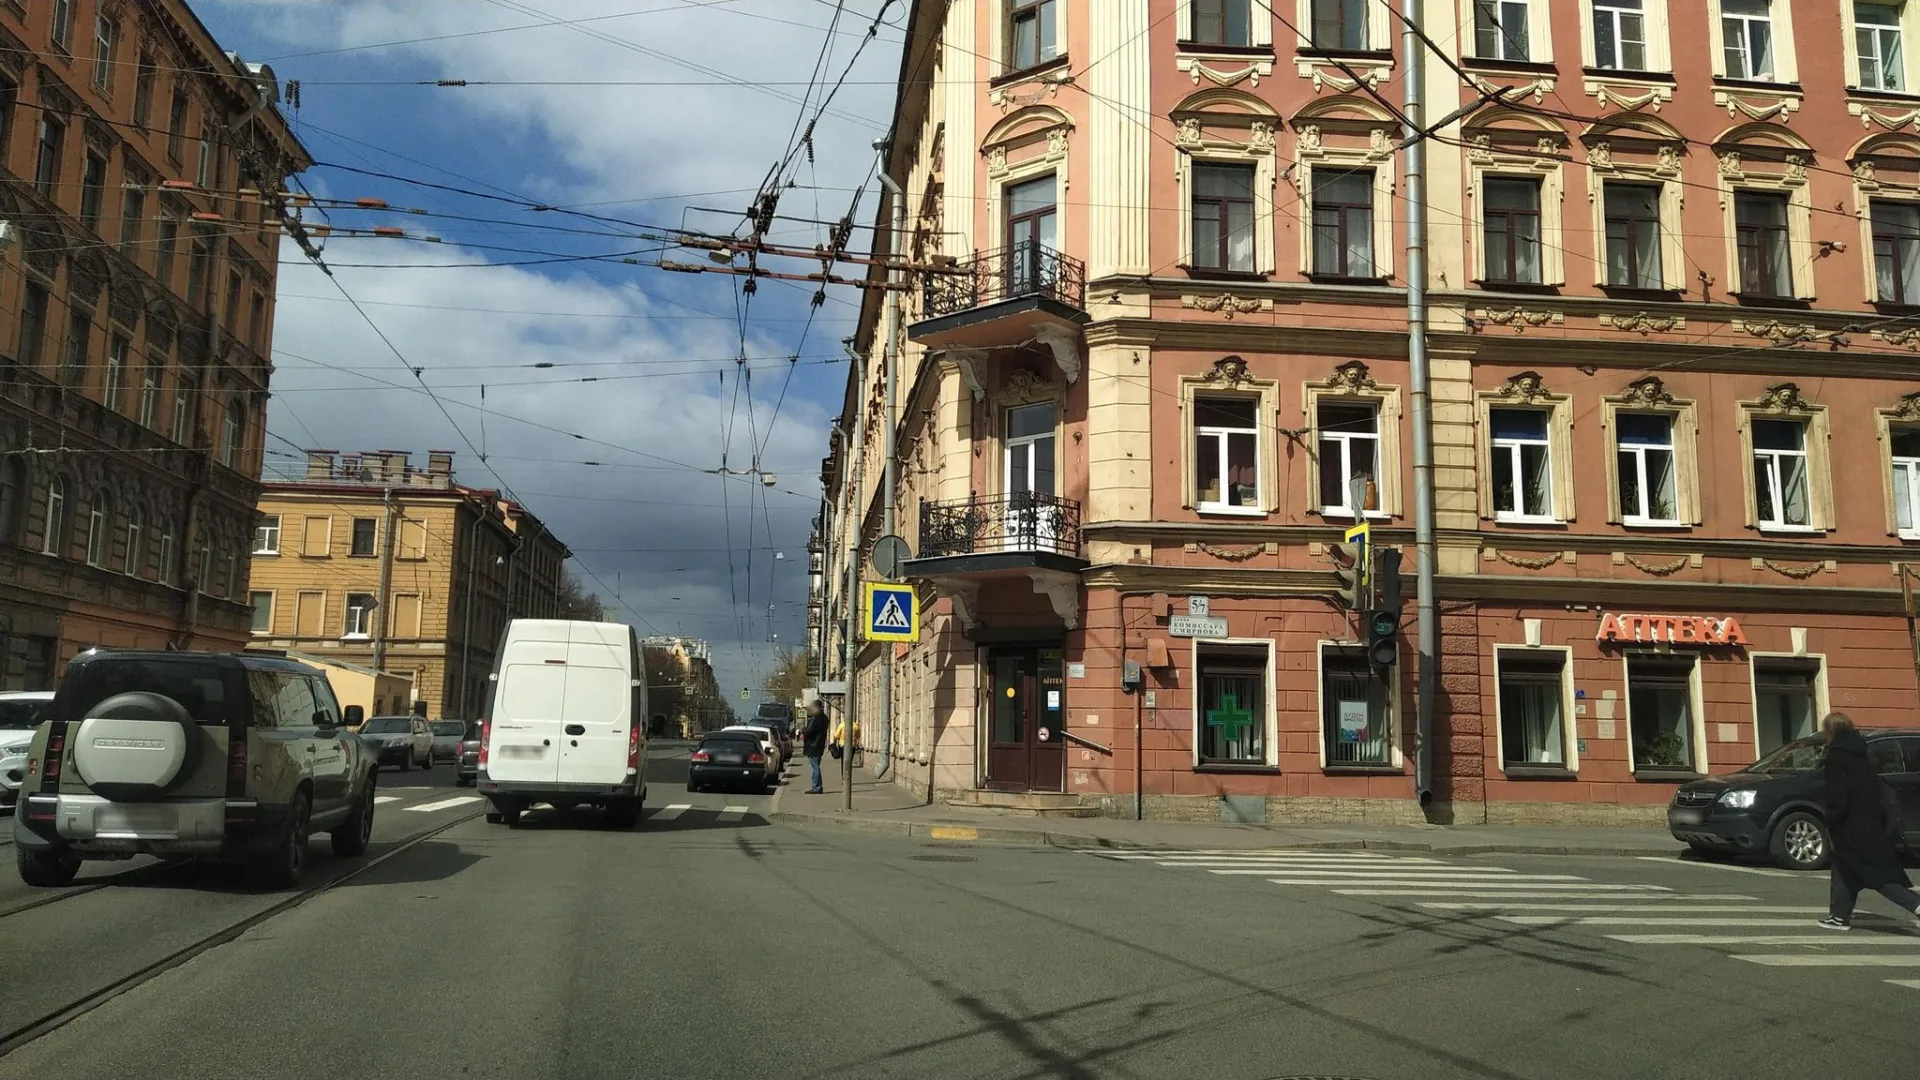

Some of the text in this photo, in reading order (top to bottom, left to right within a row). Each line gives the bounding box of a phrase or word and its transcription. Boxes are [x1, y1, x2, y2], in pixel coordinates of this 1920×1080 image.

[1192, 600, 1206, 613] 5/7
[1174, 622, 1224, 630] КОМИССАРА
[1597, 613, 1748, 645] АПТЕКА
